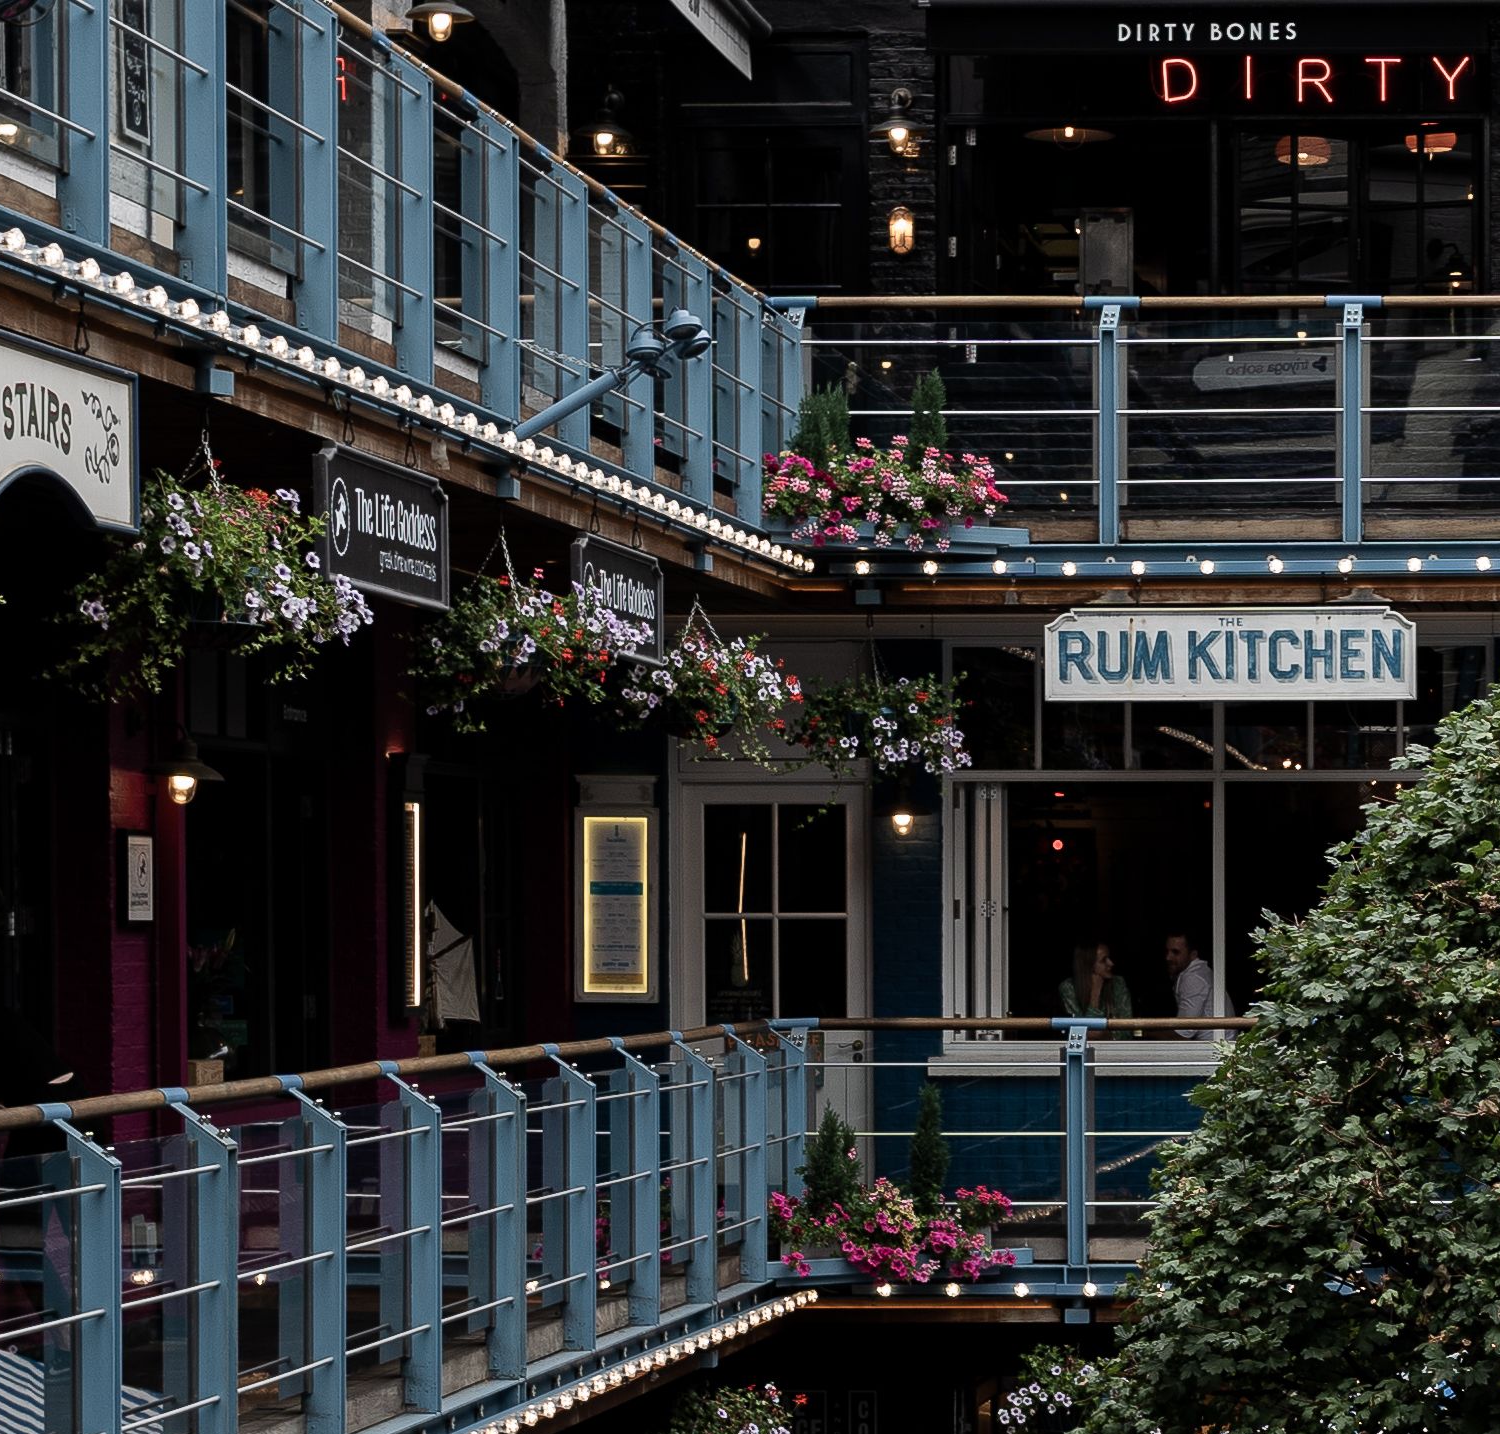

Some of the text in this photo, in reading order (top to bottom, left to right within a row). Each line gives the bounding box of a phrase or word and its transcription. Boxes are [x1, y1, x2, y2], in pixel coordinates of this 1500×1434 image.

[1117, 22, 1297, 42] DIRTY BONES
[1161, 55, 1471, 103] DIRTY
[2, 382, 72, 456] STAIRS
[354, 487, 437, 552] The Life Goddess
[599, 569, 655, 620] The Life Goddess
[1218, 617, 1244, 628] THE
[1057, 629, 1406, 684] RUM KITCHEN
